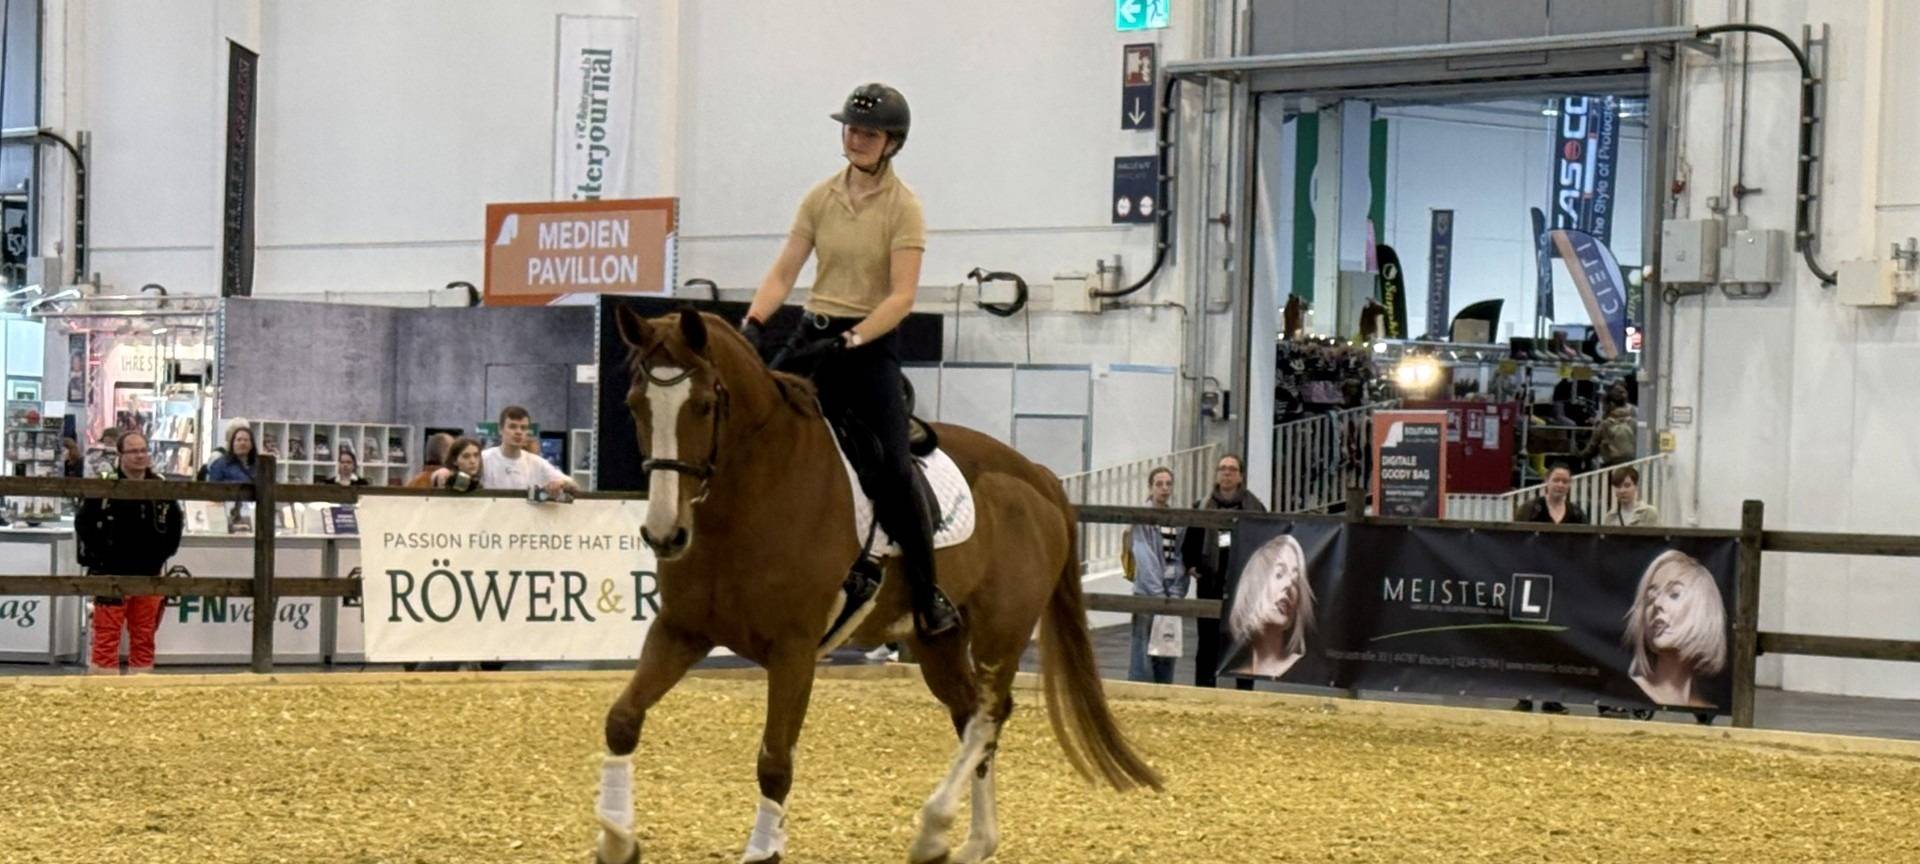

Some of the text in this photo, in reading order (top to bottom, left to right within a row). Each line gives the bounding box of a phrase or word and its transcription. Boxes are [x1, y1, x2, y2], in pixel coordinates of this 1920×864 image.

[1598, 162, 1610, 177] of
[538, 219, 630, 250] MEDIEN
[527, 254, 638, 285] PAVILLON
[1382, 455, 1417, 467] DIGITALE
[1382, 469, 1430, 480] GOODY BAG
[384, 532, 462, 550] PASSION
[469, 531, 501, 550] FÜR
[509, 533, 572, 550] PFERDE
[579, 534, 612, 550] HAT
[385, 558, 596, 622] RÖWER
[1384, 577, 1506, 607] MEISTER
